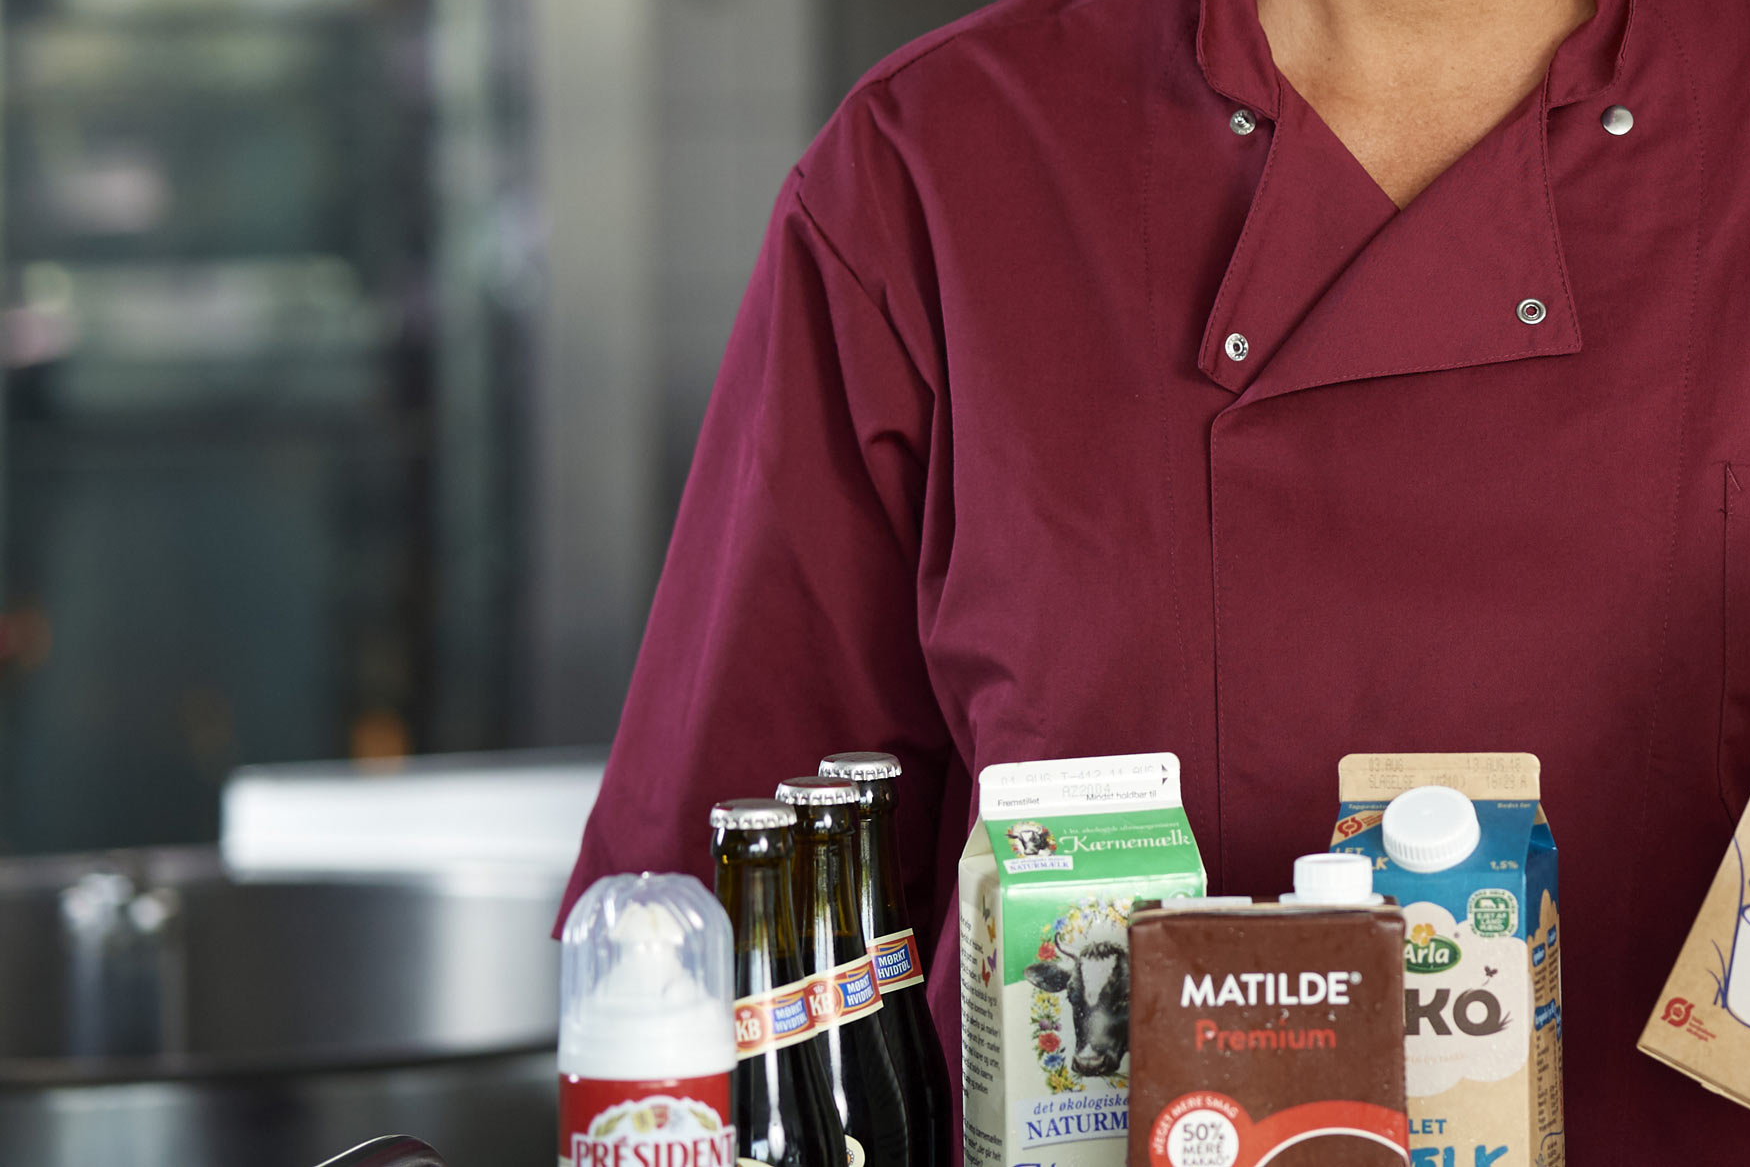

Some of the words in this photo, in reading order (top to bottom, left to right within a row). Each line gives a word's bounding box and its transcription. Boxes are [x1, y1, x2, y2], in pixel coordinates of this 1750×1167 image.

[1059, 829, 1193, 854] Kærnemælk
[878, 948, 906, 968] MØRKT
[1404, 942, 1450, 964] Arla
[877, 962, 912, 981] HVIDTØL
[808, 992, 835, 1018] KB
[1404, 988, 1514, 1037] KO
[735, 1014, 762, 1042] KB
[1194, 1018, 1337, 1052] Premium
[1033, 1102, 1054, 1116] det
[1181, 1121, 1226, 1142] 50%
[1408, 1118, 1448, 1135] LET
[571, 1132, 735, 1167] PRÉSIDENT
[1181, 1141, 1225, 1155] MERE
